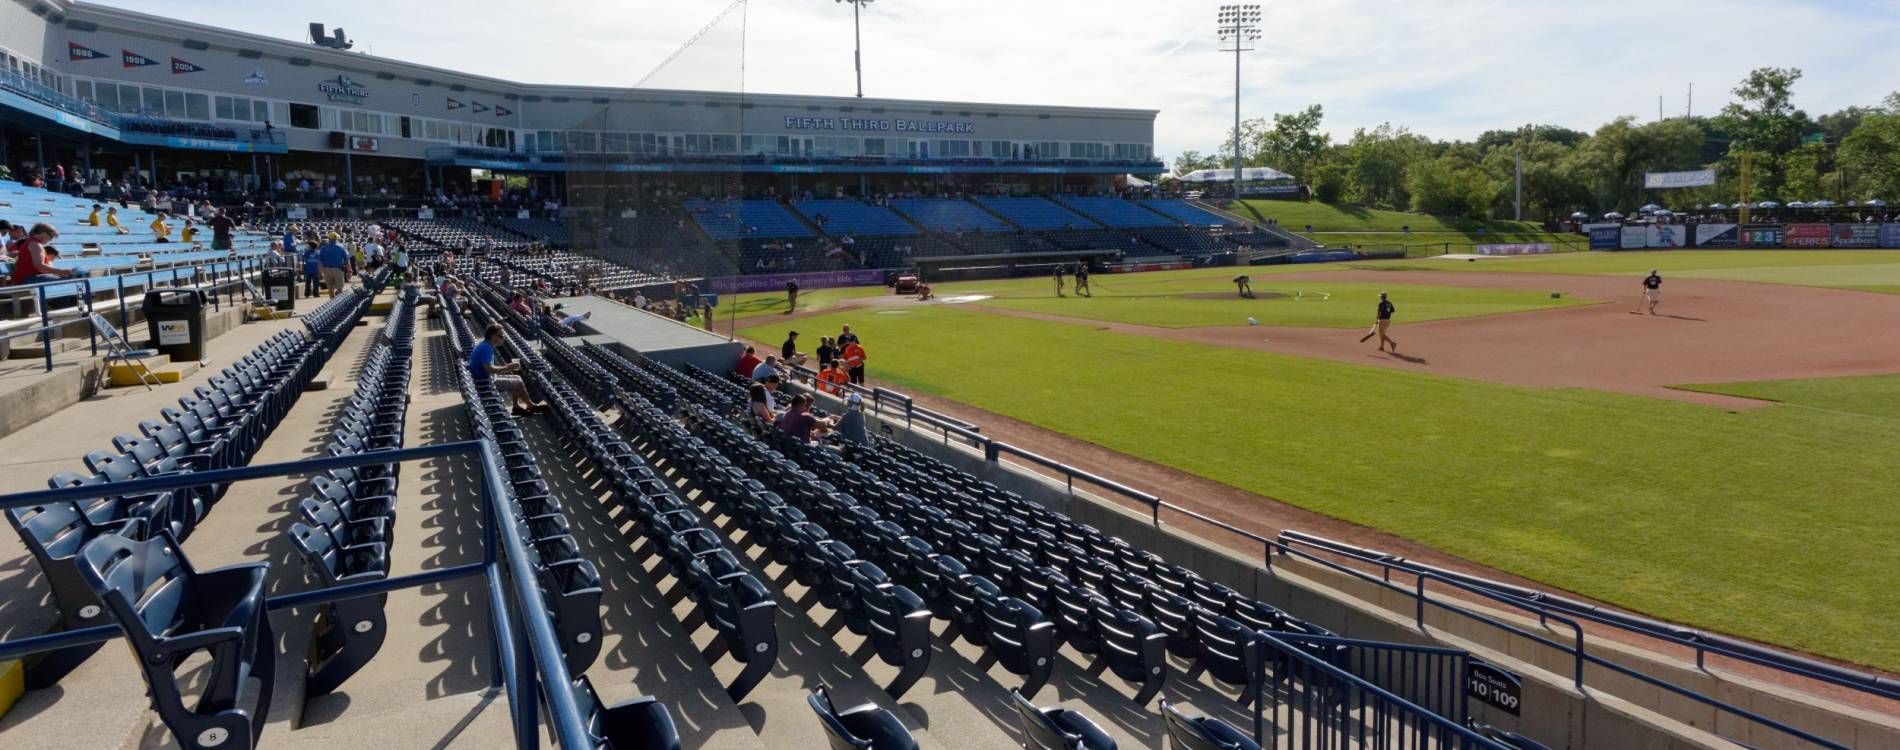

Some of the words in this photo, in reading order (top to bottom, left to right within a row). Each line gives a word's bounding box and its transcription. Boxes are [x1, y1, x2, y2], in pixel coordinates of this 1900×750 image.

[320, 84, 345, 94] FIFTH
[785, 115, 834, 129] FIFTH
[841, 117, 889, 131] THIRD
[896, 119, 976, 133] BALLPARK
[1493, 689, 1518, 708] 109
